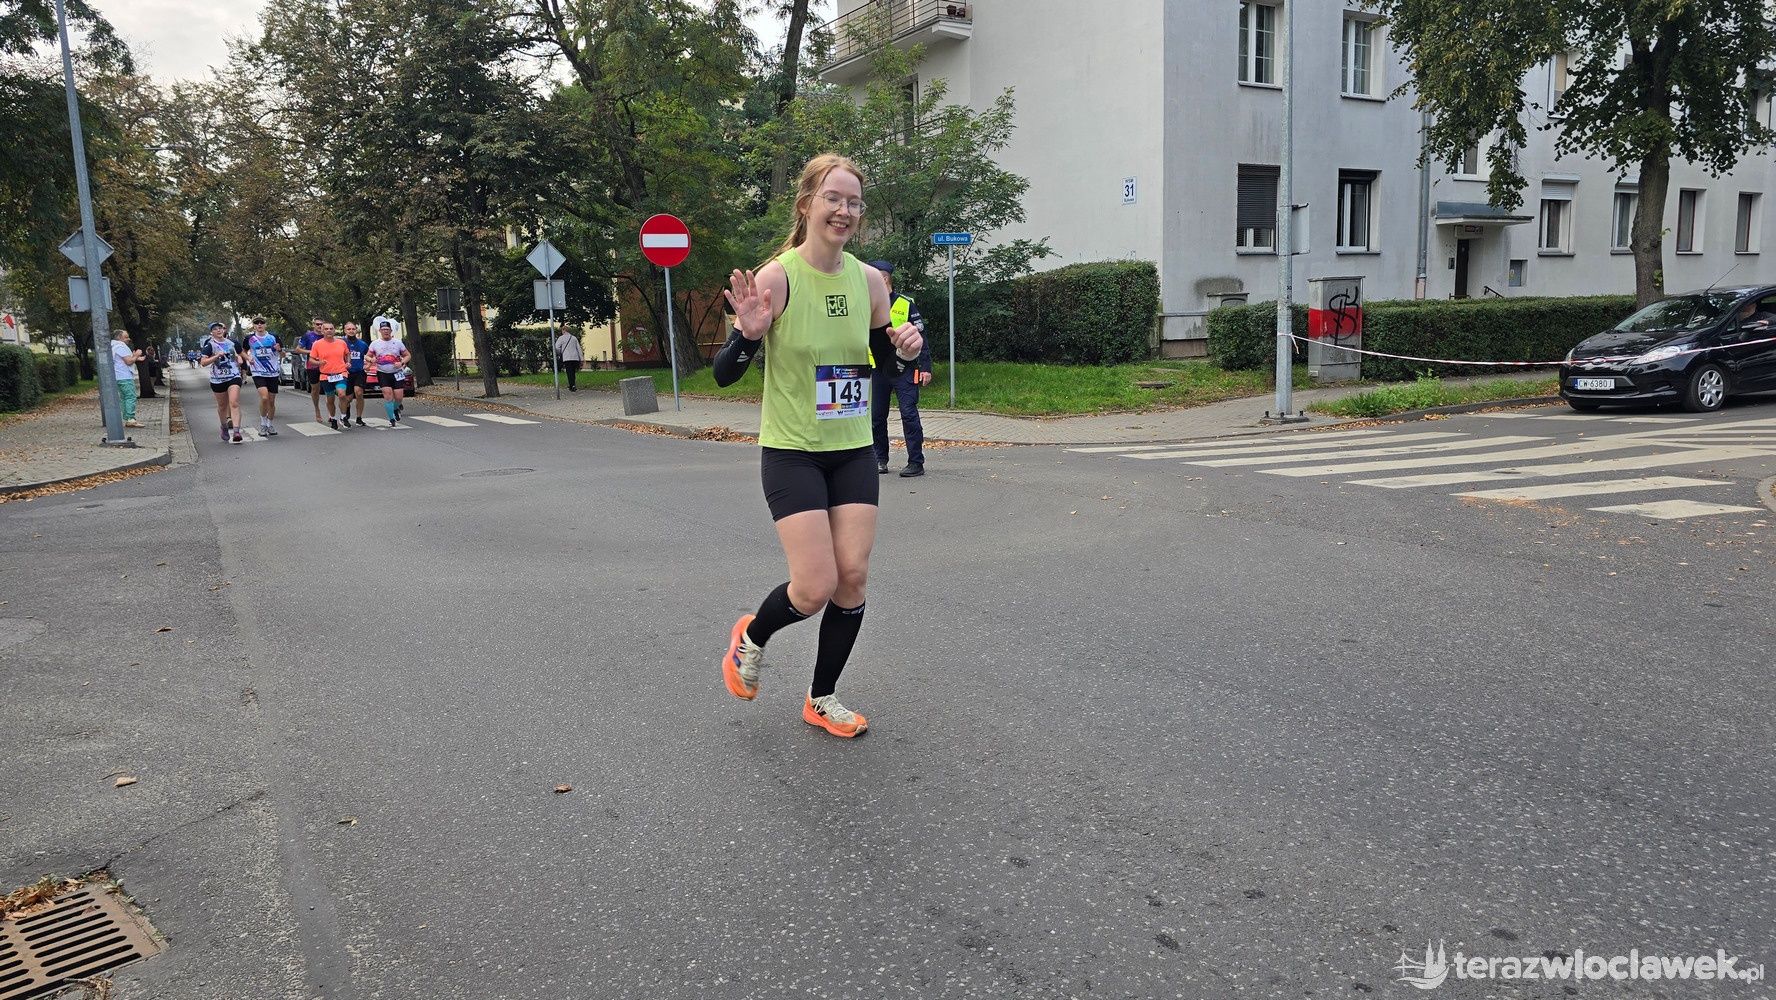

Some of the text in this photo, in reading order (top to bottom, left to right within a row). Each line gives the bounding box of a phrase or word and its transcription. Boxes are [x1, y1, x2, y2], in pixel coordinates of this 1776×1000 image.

[1124, 184, 1134, 197] 31
[1579, 379, 1612, 388] CW 6380J
[828, 380, 862, 403] 143
